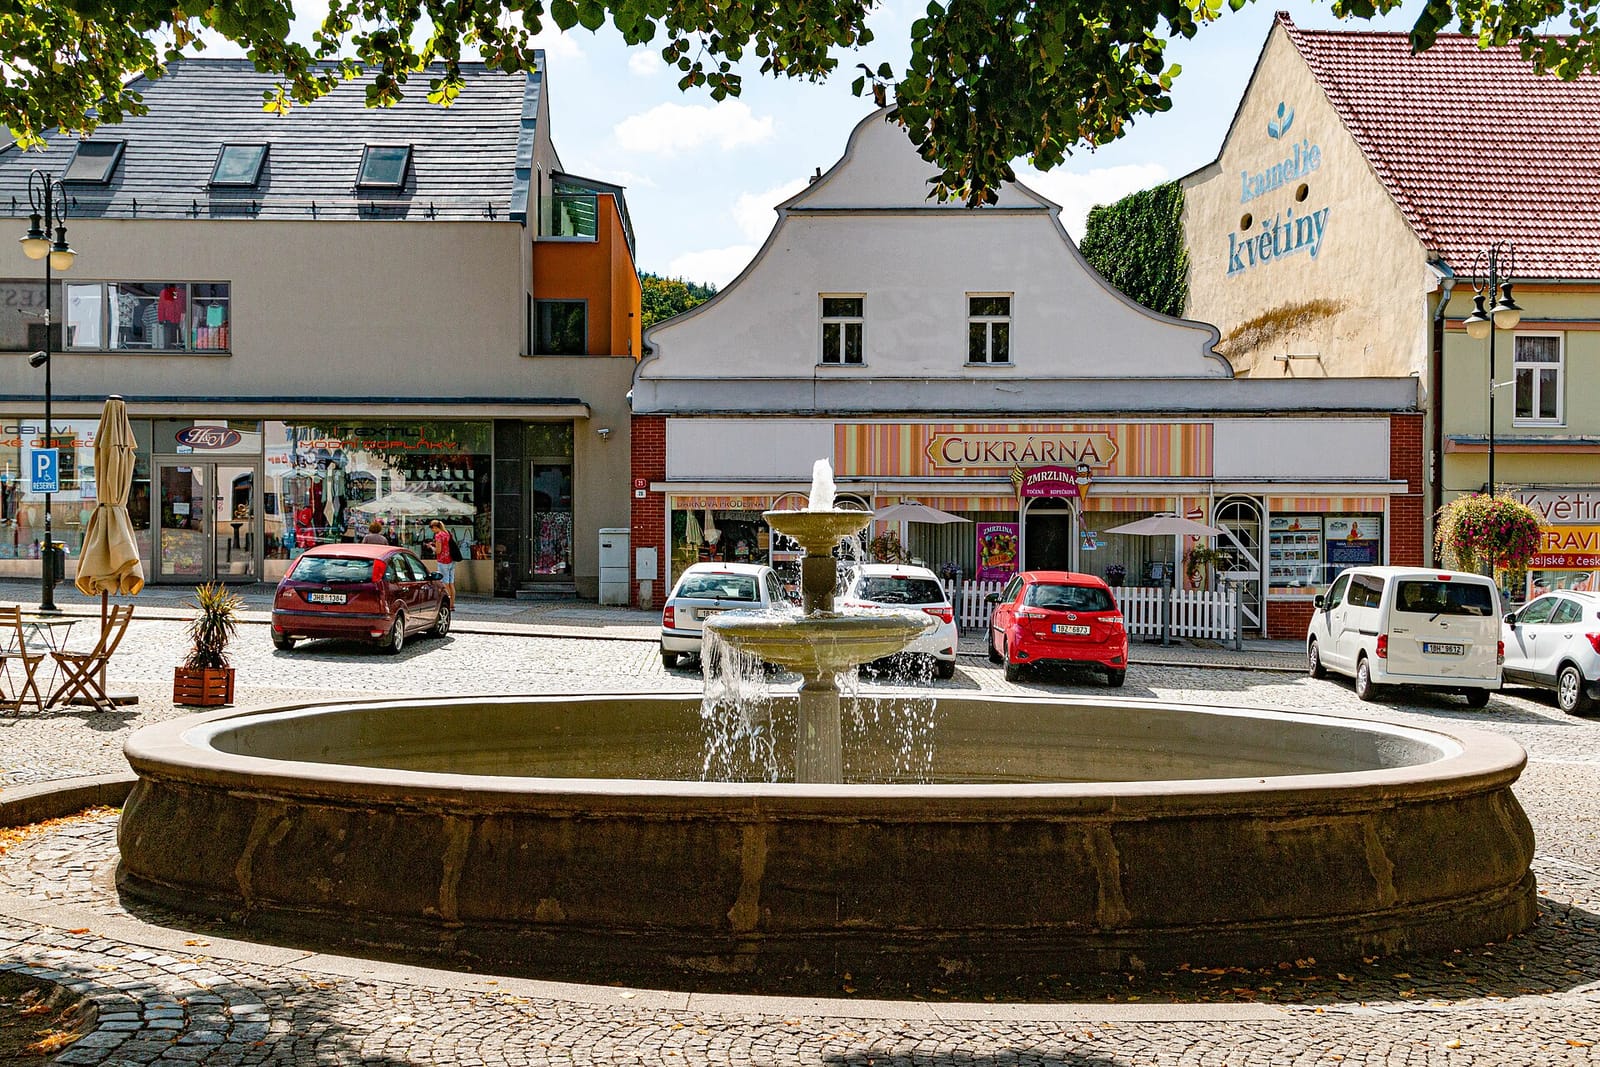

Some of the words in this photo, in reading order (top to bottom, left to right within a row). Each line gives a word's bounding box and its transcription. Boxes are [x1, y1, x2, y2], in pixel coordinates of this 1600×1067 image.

[1240, 138, 1321, 204] kamelie
[1227, 207, 1330, 277] květiny
[185, 428, 232, 446] H&N
[340, 427, 420, 437] TEXTIL
[942, 437, 1101, 463] CUKRÁRNA
[37, 455, 50, 478] P
[1027, 471, 1075, 486] ZMRZLINA
[983, 526, 1013, 535] ZMRZLINA
[1566, 556, 1574, 566] &
